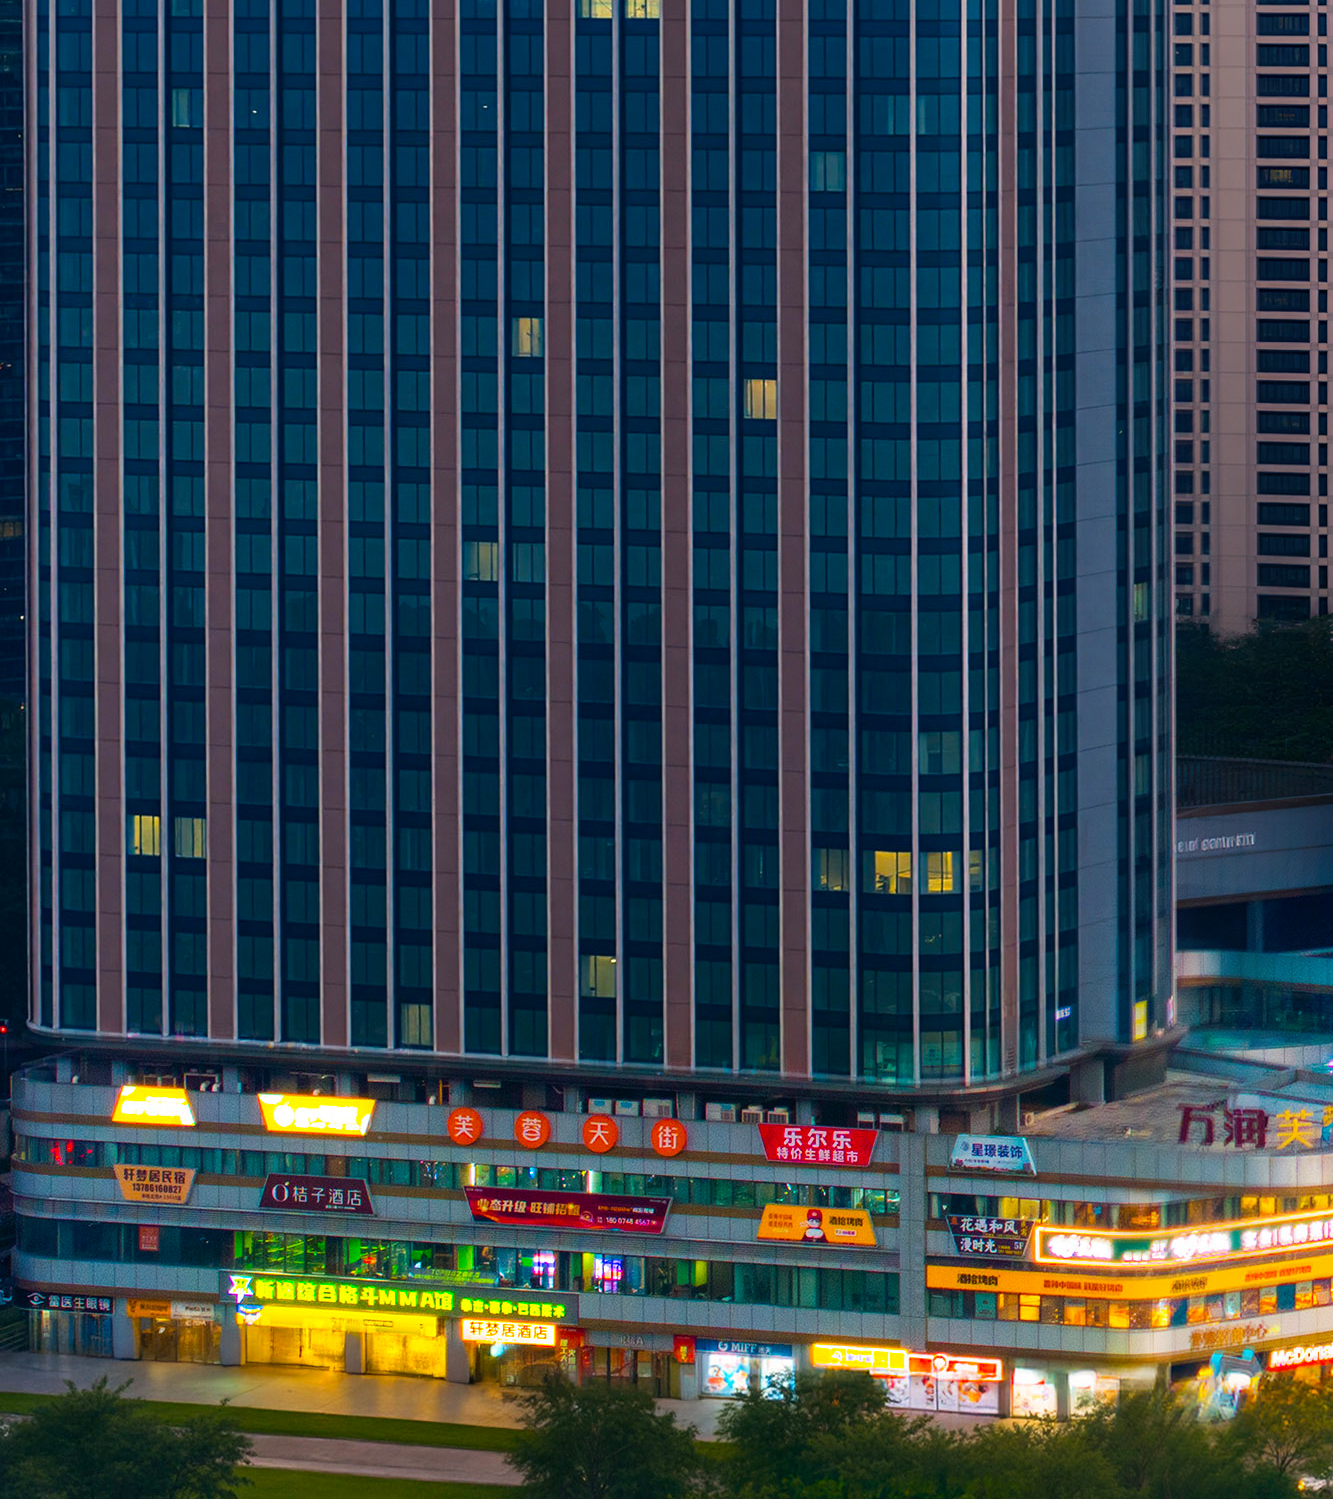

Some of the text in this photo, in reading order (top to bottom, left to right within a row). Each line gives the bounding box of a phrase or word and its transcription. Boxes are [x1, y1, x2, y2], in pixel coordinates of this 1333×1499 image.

[454, 1114, 680, 1151] 芙蓉天街
[783, 1128, 852, 1149] 乐尔乐
[777, 1147, 859, 1163] 特价生鲜超市
[123, 1168, 186, 1185] 轩梦居民宿
[292, 1186, 362, 1207] 桔子酒店
[960, 1237, 998, 1254] 漫时光
[48, 1294, 111, 1311] 雷医生眼镜
[470, 1321, 548, 1340] 轩梦居酒店
